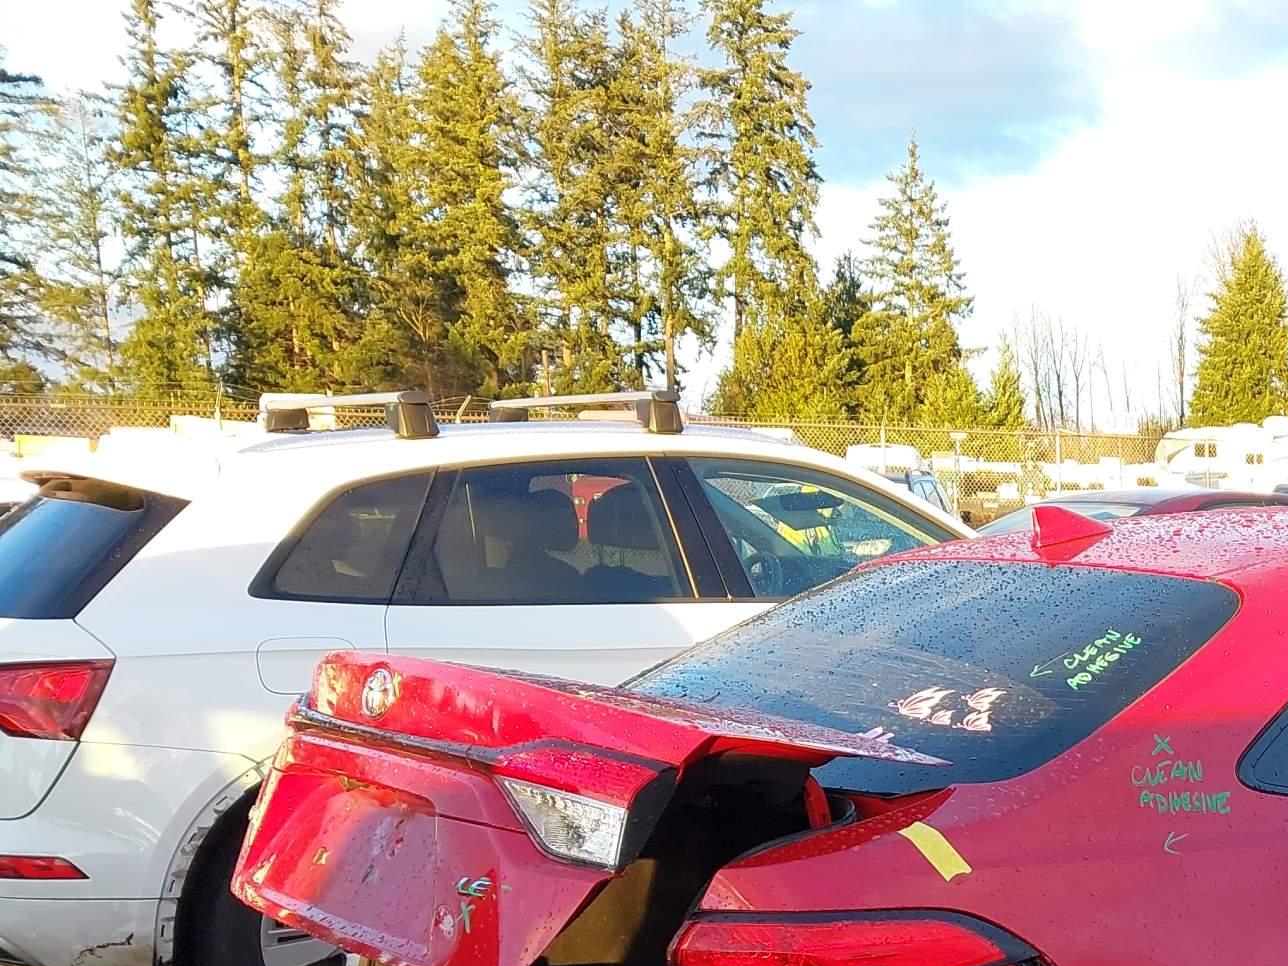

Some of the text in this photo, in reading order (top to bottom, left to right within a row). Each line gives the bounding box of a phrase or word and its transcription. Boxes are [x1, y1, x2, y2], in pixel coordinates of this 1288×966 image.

[1063, 628, 1121, 669] CLEAN
[1131, 760, 1203, 787] CLEAN
[1138, 790, 1232, 815] ADHESIVE
[456, 877, 493, 898] LE
